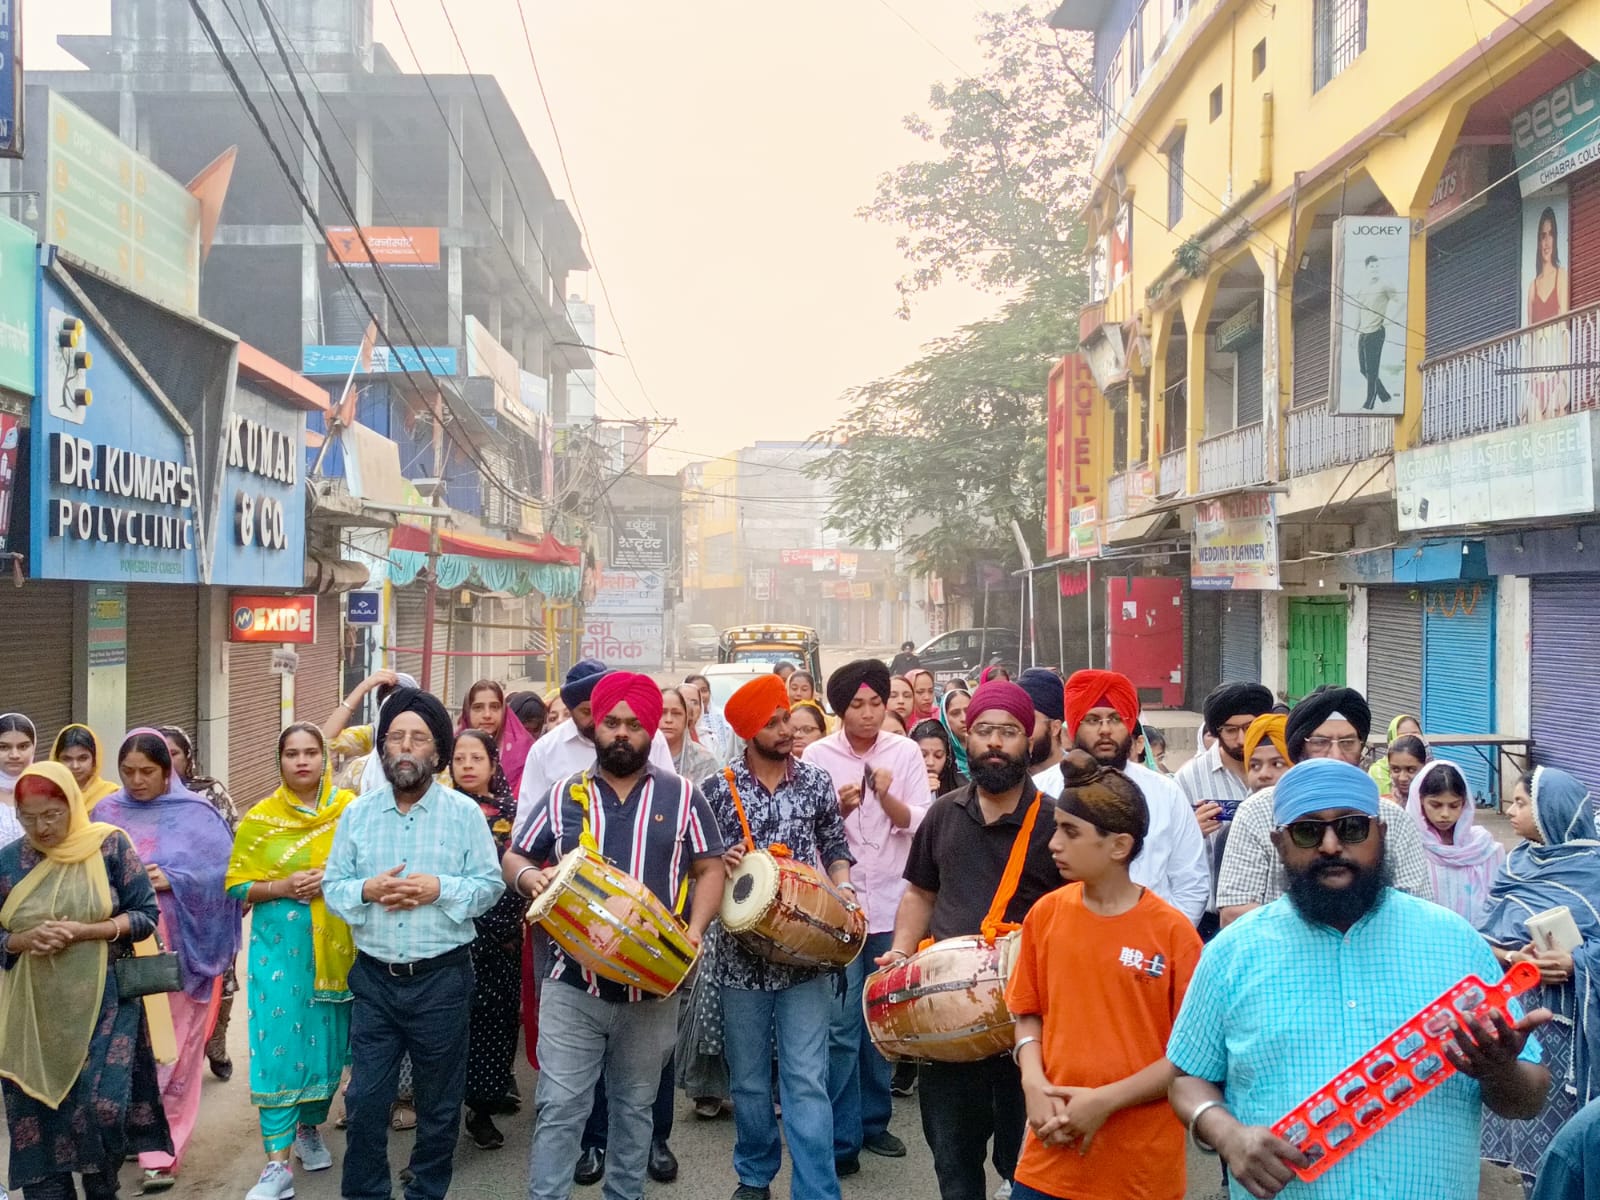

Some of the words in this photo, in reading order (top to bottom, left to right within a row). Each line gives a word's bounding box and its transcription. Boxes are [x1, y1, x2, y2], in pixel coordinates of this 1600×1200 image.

[1540, 158, 1576, 185] CHHABRA
[1352, 225, 1403, 236] JOCKEY
[1074, 354, 1092, 493] HOTEL
[228, 412, 297, 485] KUMAR
[1462, 440, 1518, 469] PLASTIC
[1521, 437, 1533, 460] &
[1537, 427, 1586, 458] STEEL
[59, 431, 99, 491] DR.
[105, 445, 193, 508] KUMAR'S
[59, 498, 192, 550] POLYCLINIC
[240, 491, 255, 547] &
[260, 495, 288, 551] CO.
[1199, 545, 1230, 561] WEDDING
[1231, 543, 1265, 561] PLANNER
[253, 607, 311, 632] EXIDE
[581, 636, 643, 659] टोनिक
